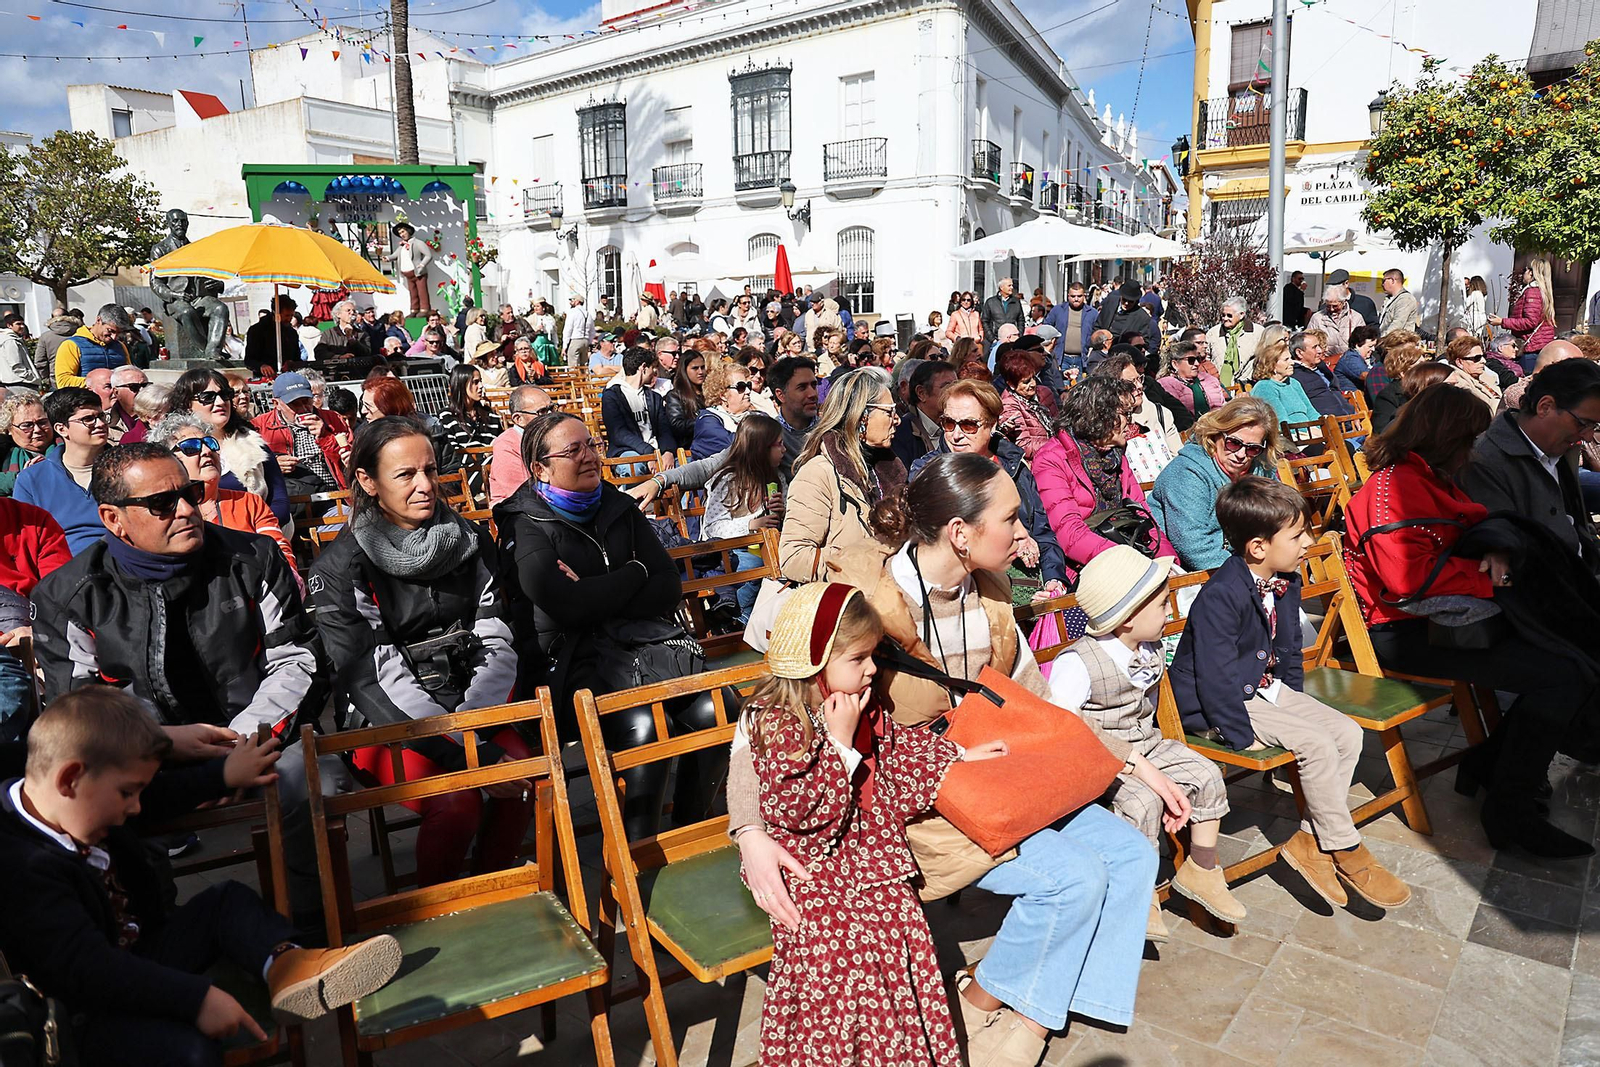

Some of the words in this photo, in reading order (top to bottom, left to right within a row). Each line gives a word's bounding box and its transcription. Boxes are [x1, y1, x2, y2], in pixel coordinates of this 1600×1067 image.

[1315, 181, 1353, 190] PLAZA
[1301, 196, 1322, 205] DEL
[1325, 194, 1371, 203] CABILD
[339, 203, 378, 212] MOGUER
[347, 214, 373, 222] 2024
